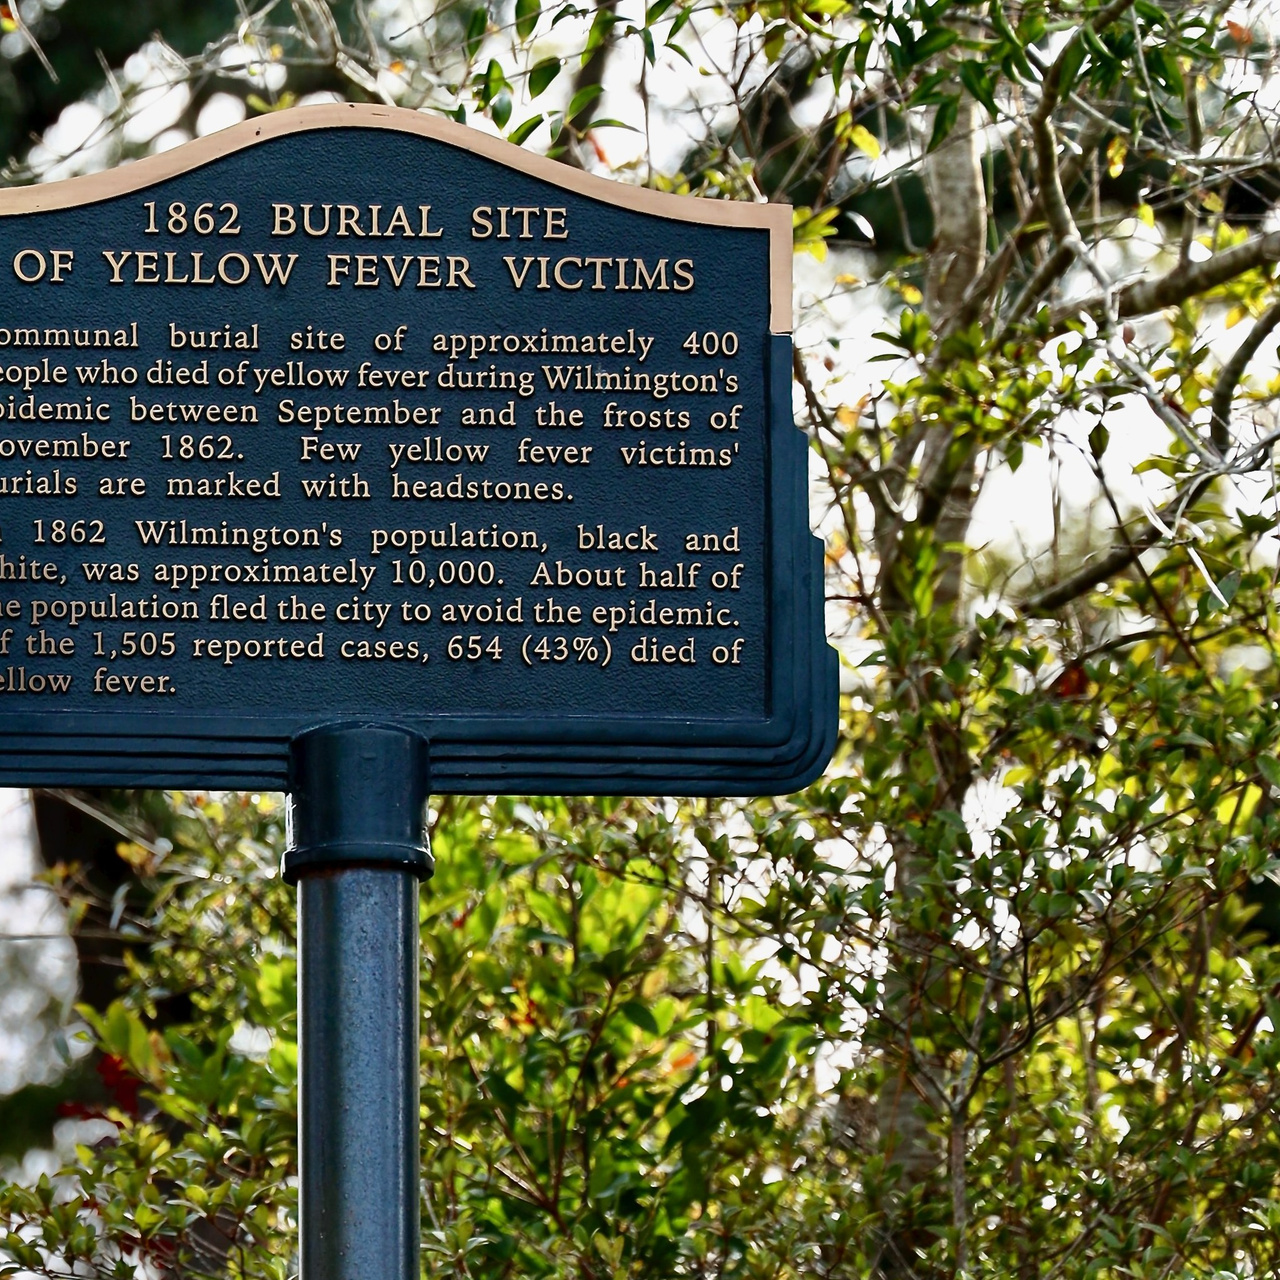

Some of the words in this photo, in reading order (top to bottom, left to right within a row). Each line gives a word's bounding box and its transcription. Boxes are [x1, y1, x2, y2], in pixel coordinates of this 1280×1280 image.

[143, 201, 241, 234] 1862
[271, 203, 443, 237] BURIAL
[471, 205, 569, 239] SITE
[13, 249, 74, 282] OF
[102, 250, 299, 285] YELLOW
[326, 254, 476, 288] FEVER
[503, 256, 695, 291] VICTIMS
[169, 322, 259, 349] burial
[290, 325, 345, 350] site
[374, 325, 408, 351] of
[433, 327, 655, 362] approximately
[682, 331, 739, 356] 400
[75, 359, 138, 384] who
[146, 359, 209, 385] died
[217, 360, 250, 385] of
[253, 361, 350, 393] yellow
[357, 361, 430, 388] fever
[437, 362, 535, 397] during
[541, 364, 739, 399] Wilmington's
[129, 395, 259, 423] between
[278, 399, 442, 431] September
[461, 400, 516, 426] and
[535, 401, 584, 427] the
[603, 401, 691, 429] frosts
[710, 404, 743, 430] of
[161, 434, 244, 459] 1862.
[300, 436, 362, 461] Few
[388, 436, 490, 469] yellow
[517, 437, 593, 464] fever
[620, 440, 739, 466] victims'
[99, 477, 146, 496] are
[167, 471, 281, 497] marked
[301, 472, 371, 498] with
[391, 472, 574, 500] headstones.
[33, 519, 106, 543] 1862
[135, 519, 343, 553] Wilmington's
[370, 522, 548, 555] population,
[577, 523, 659, 551] black
[685, 526, 740, 552] and
[82, 563, 140, 581] was
[154, 558, 377, 591] approximately
[392, 559, 504, 588] 10,000.
[529, 560, 627, 587] About
[639, 561, 702, 588] half
[711, 563, 745, 589] of
[30, 593, 199, 625] population
[209, 593, 267, 620] fled
[277, 594, 326, 621] the
[336, 595, 391, 629] city
[401, 601, 432, 622] to
[441, 596, 524, 623] avoid
[533, 597, 582, 624] the
[592, 599, 740, 632] epidemic.
[25, 629, 75, 655] the
[93, 631, 176, 660] 1,505
[193, 632, 325, 665] reported
[340, 640, 429, 663] cases,
[447, 635, 503, 660] 654
[522, 635, 612, 667] (43%)
[631, 636, 696, 663] died
[712, 637, 745, 664] of
[93, 666, 176, 693] fever.
